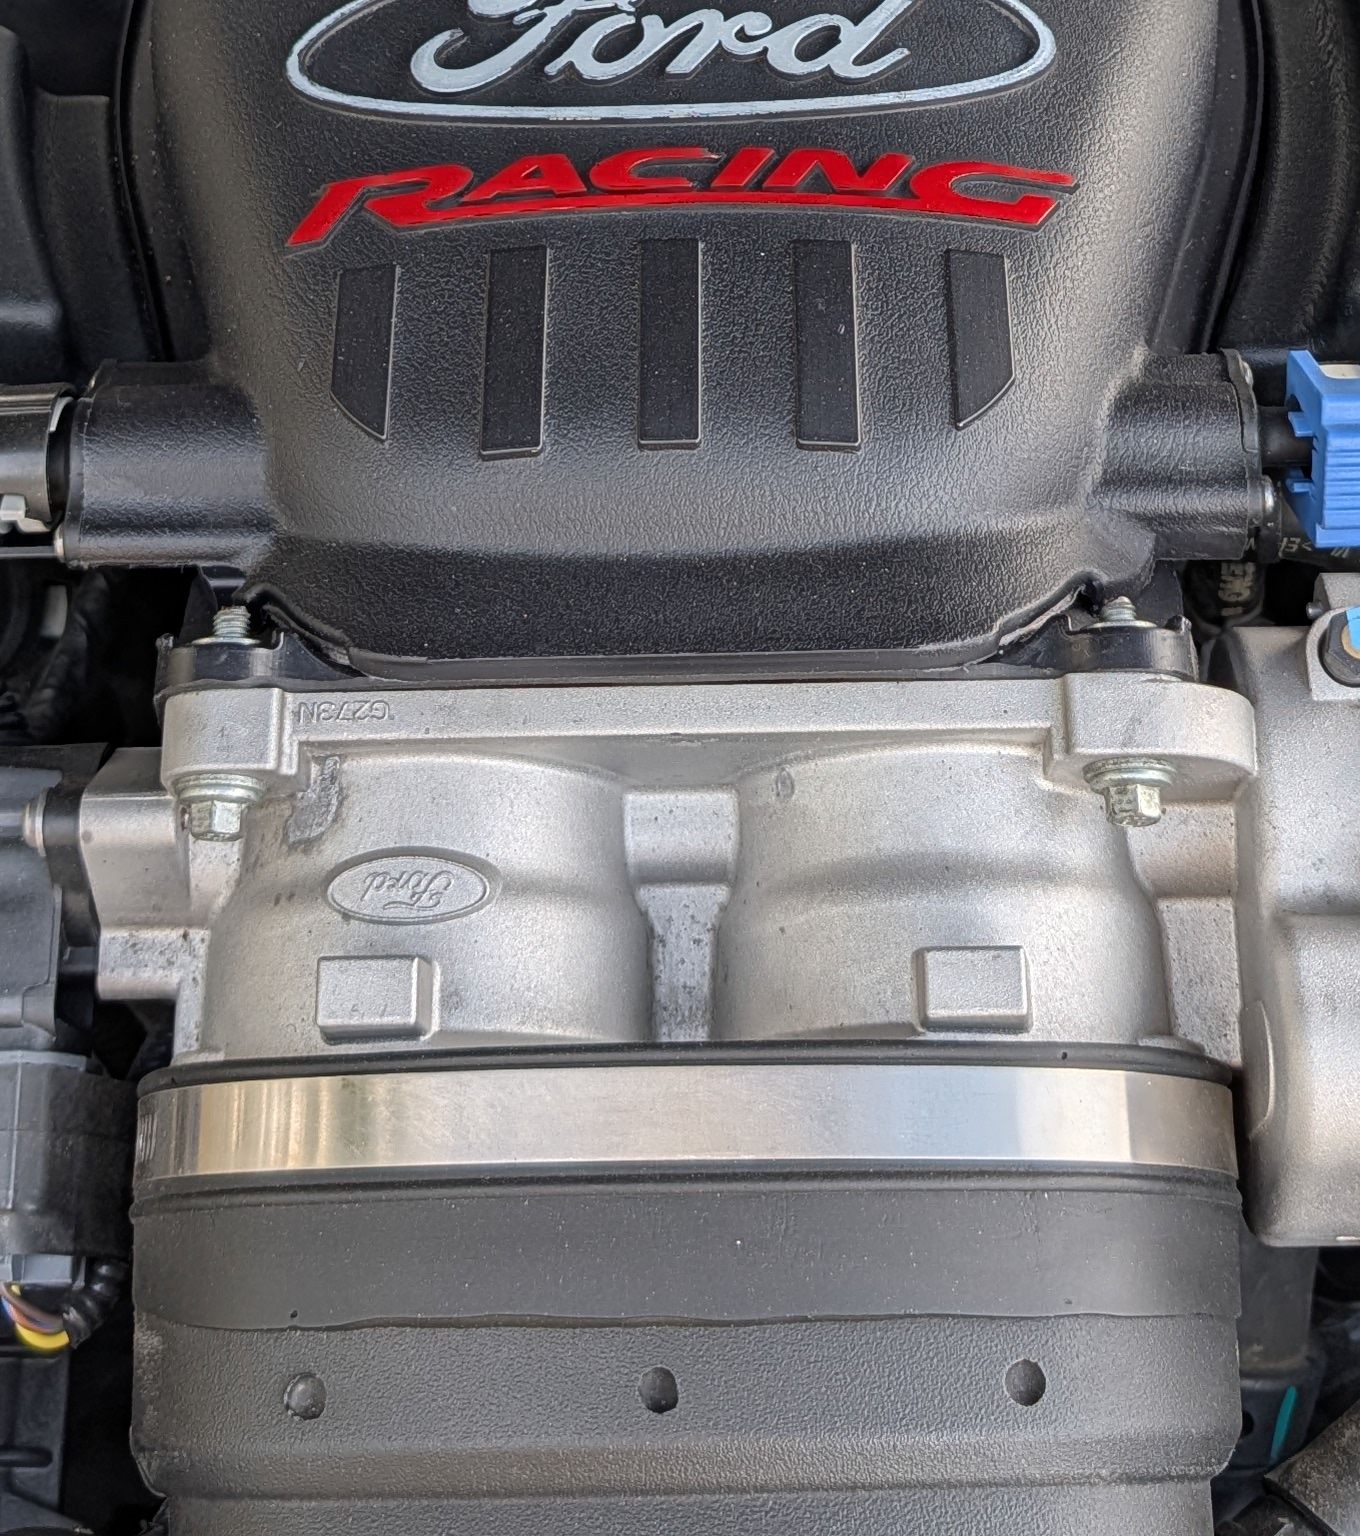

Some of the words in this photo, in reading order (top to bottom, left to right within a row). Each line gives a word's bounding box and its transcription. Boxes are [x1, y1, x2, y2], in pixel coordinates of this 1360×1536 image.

[284, 144, 1082, 249] RACING
[297, 698, 391, 724] G273N
[359, 869, 456, 911] Ford
